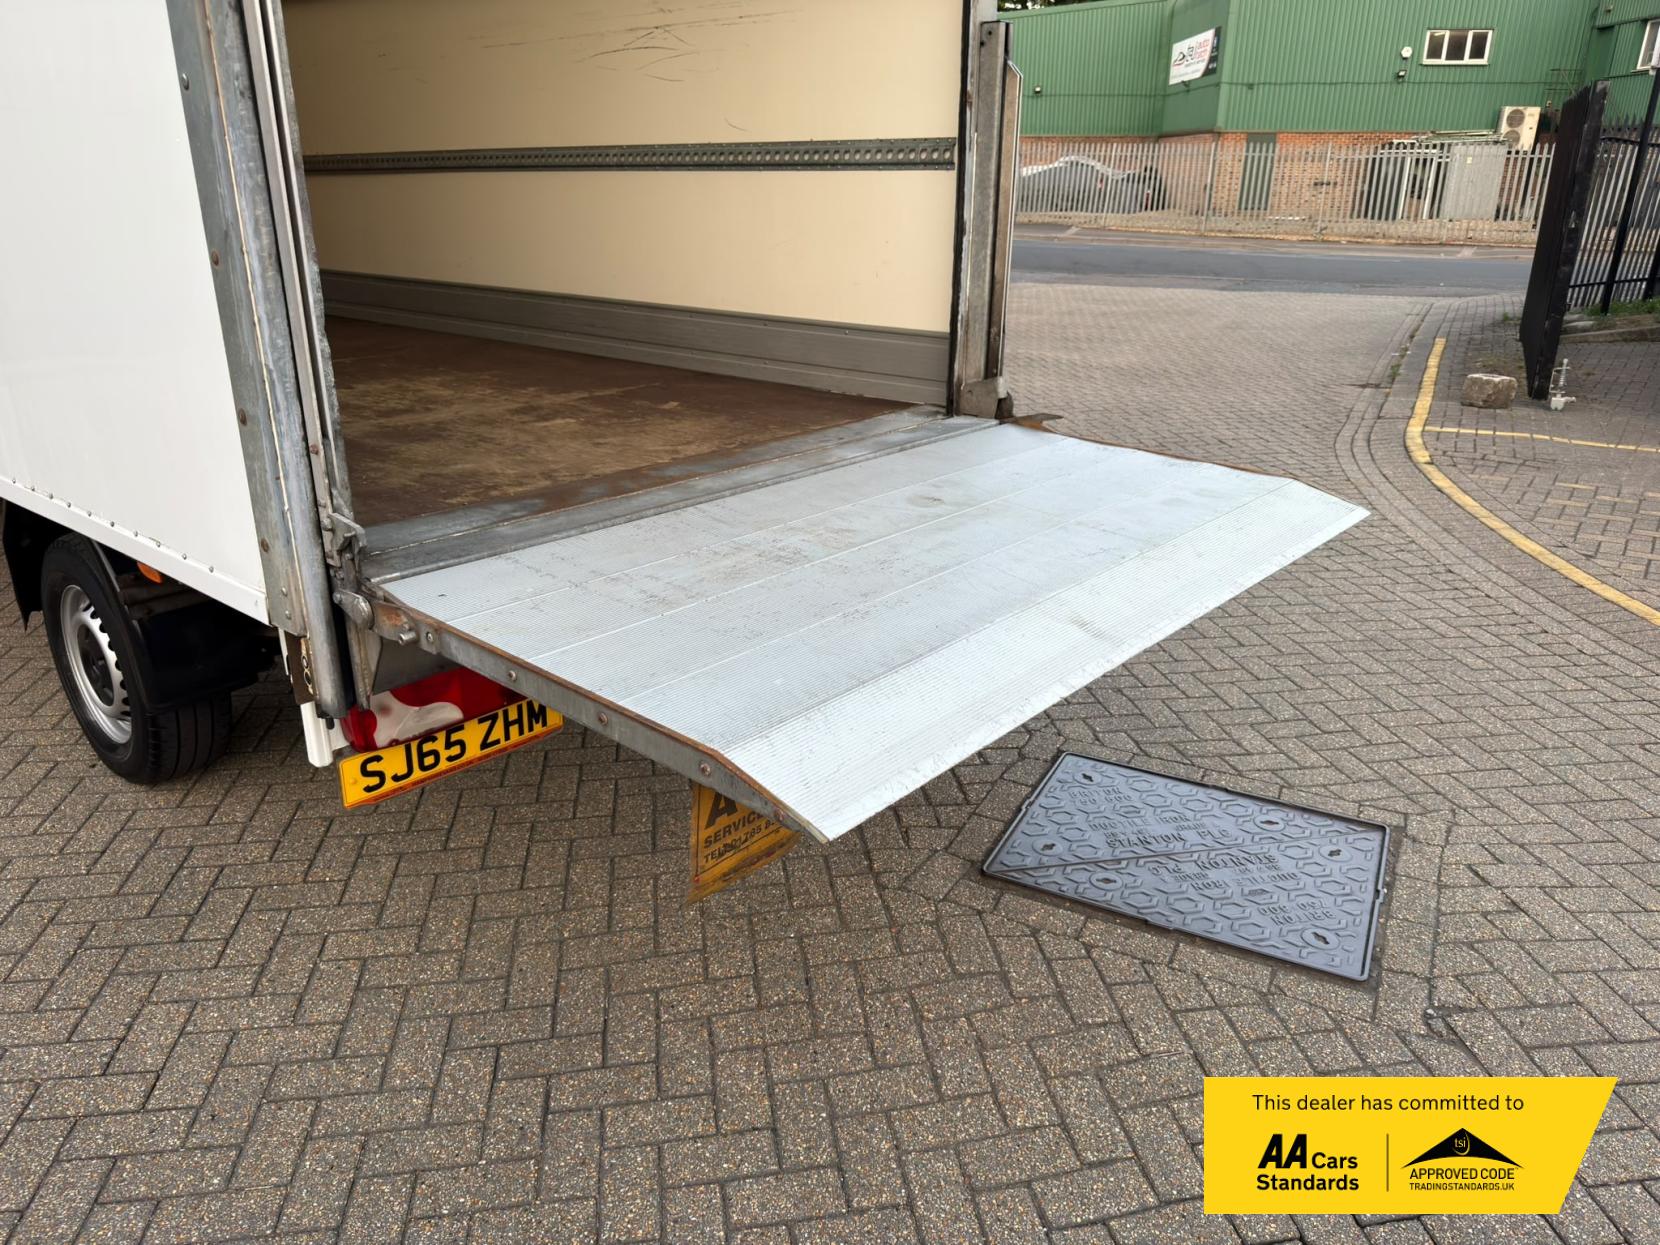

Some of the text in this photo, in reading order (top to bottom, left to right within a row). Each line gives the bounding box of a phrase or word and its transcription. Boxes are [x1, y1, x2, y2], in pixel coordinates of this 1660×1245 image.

[359, 725, 467, 793] SJ65
[477, 700, 548, 750] ZHM
[1105, 832, 1187, 848] STANTON
[1196, 828, 1233, 841] PLC
[1194, 853, 1279, 871] STANTON
[1269, 909, 1337, 926] BRITON
